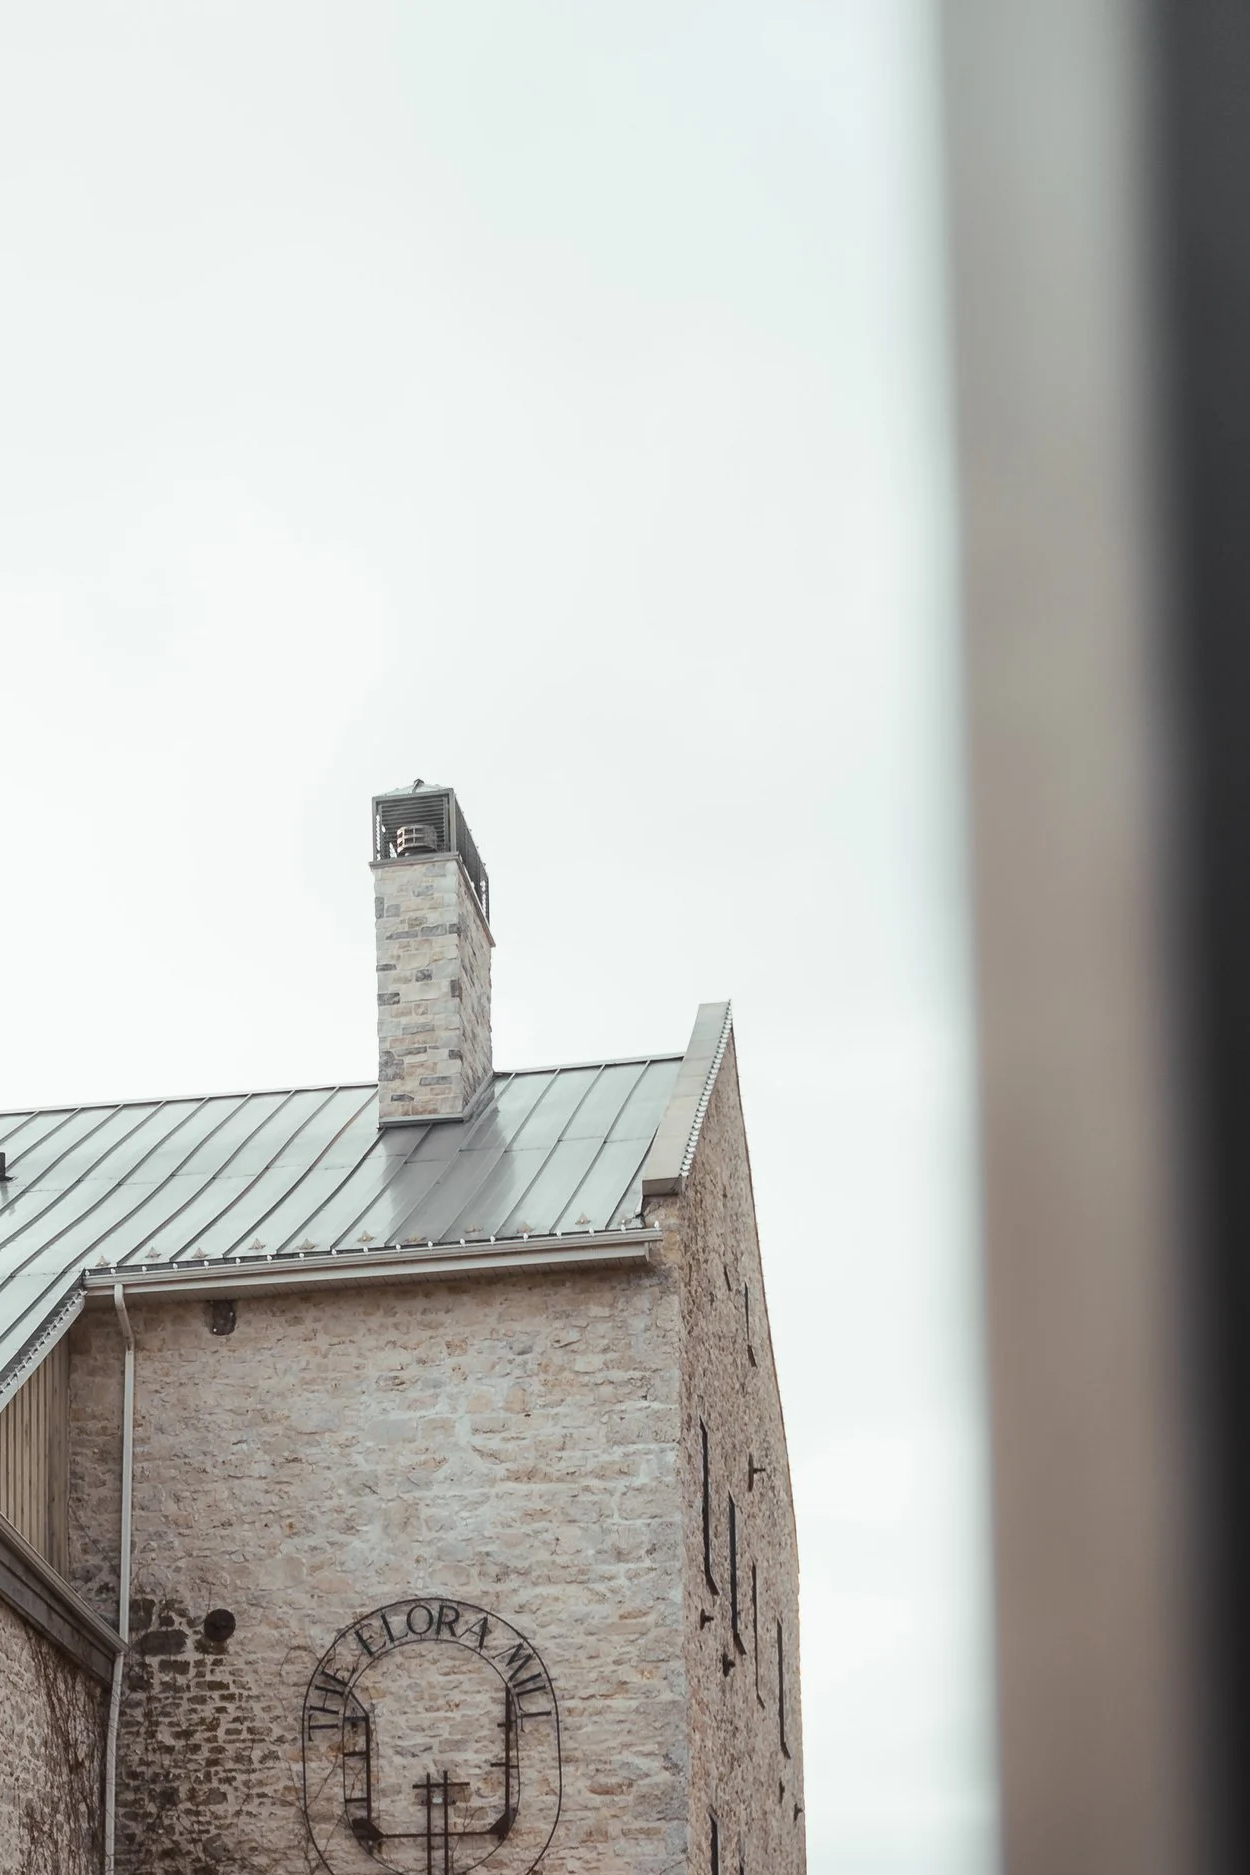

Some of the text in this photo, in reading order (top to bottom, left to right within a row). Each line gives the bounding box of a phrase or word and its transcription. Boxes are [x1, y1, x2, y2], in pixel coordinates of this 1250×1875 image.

[308, 1604, 552, 1742] THE ELORA MILL
